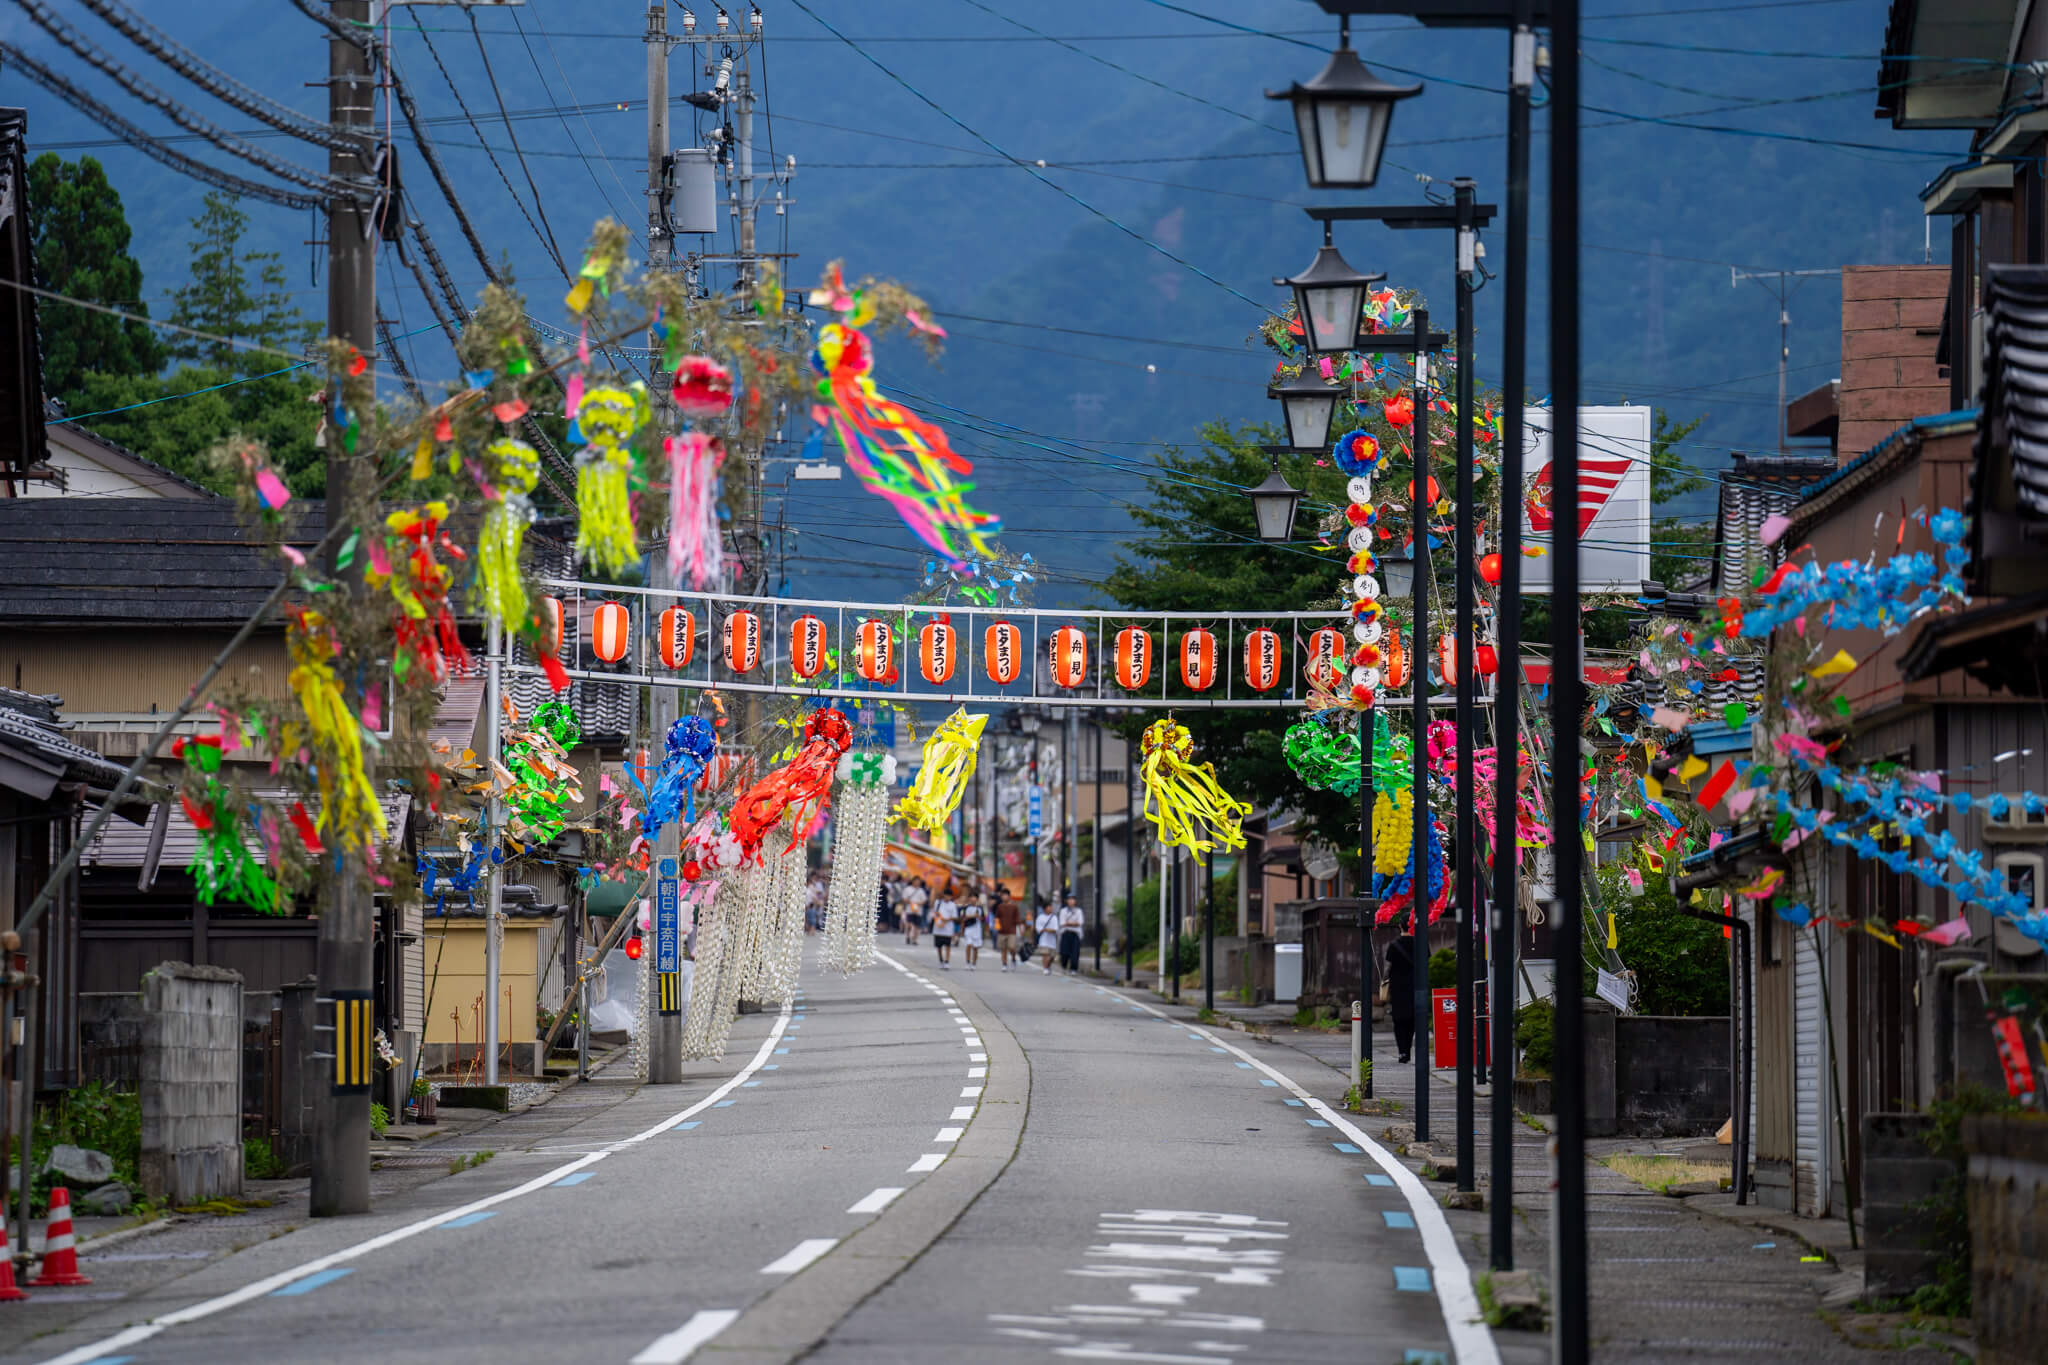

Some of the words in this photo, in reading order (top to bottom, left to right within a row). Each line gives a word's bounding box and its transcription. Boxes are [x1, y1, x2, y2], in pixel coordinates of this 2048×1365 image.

[674, 612, 687, 662] 七夕まつり
[747, 616, 757, 667] 七夕まつり
[806, 621, 819, 671] 七夕まつり
[876, 625, 887, 674] 七夕まつり
[934, 627, 946, 677] 七夕まつり
[997, 627, 1010, 677] 七夕まつり
[1071, 640, 1083, 676] 舟見
[1132, 633, 1144, 683] 七夕まつり
[1188, 641, 1201, 677] 舟見
[1262, 634, 1274, 684] 七夕まつり
[660, 882, 676, 970] 朝日宇奈月線
